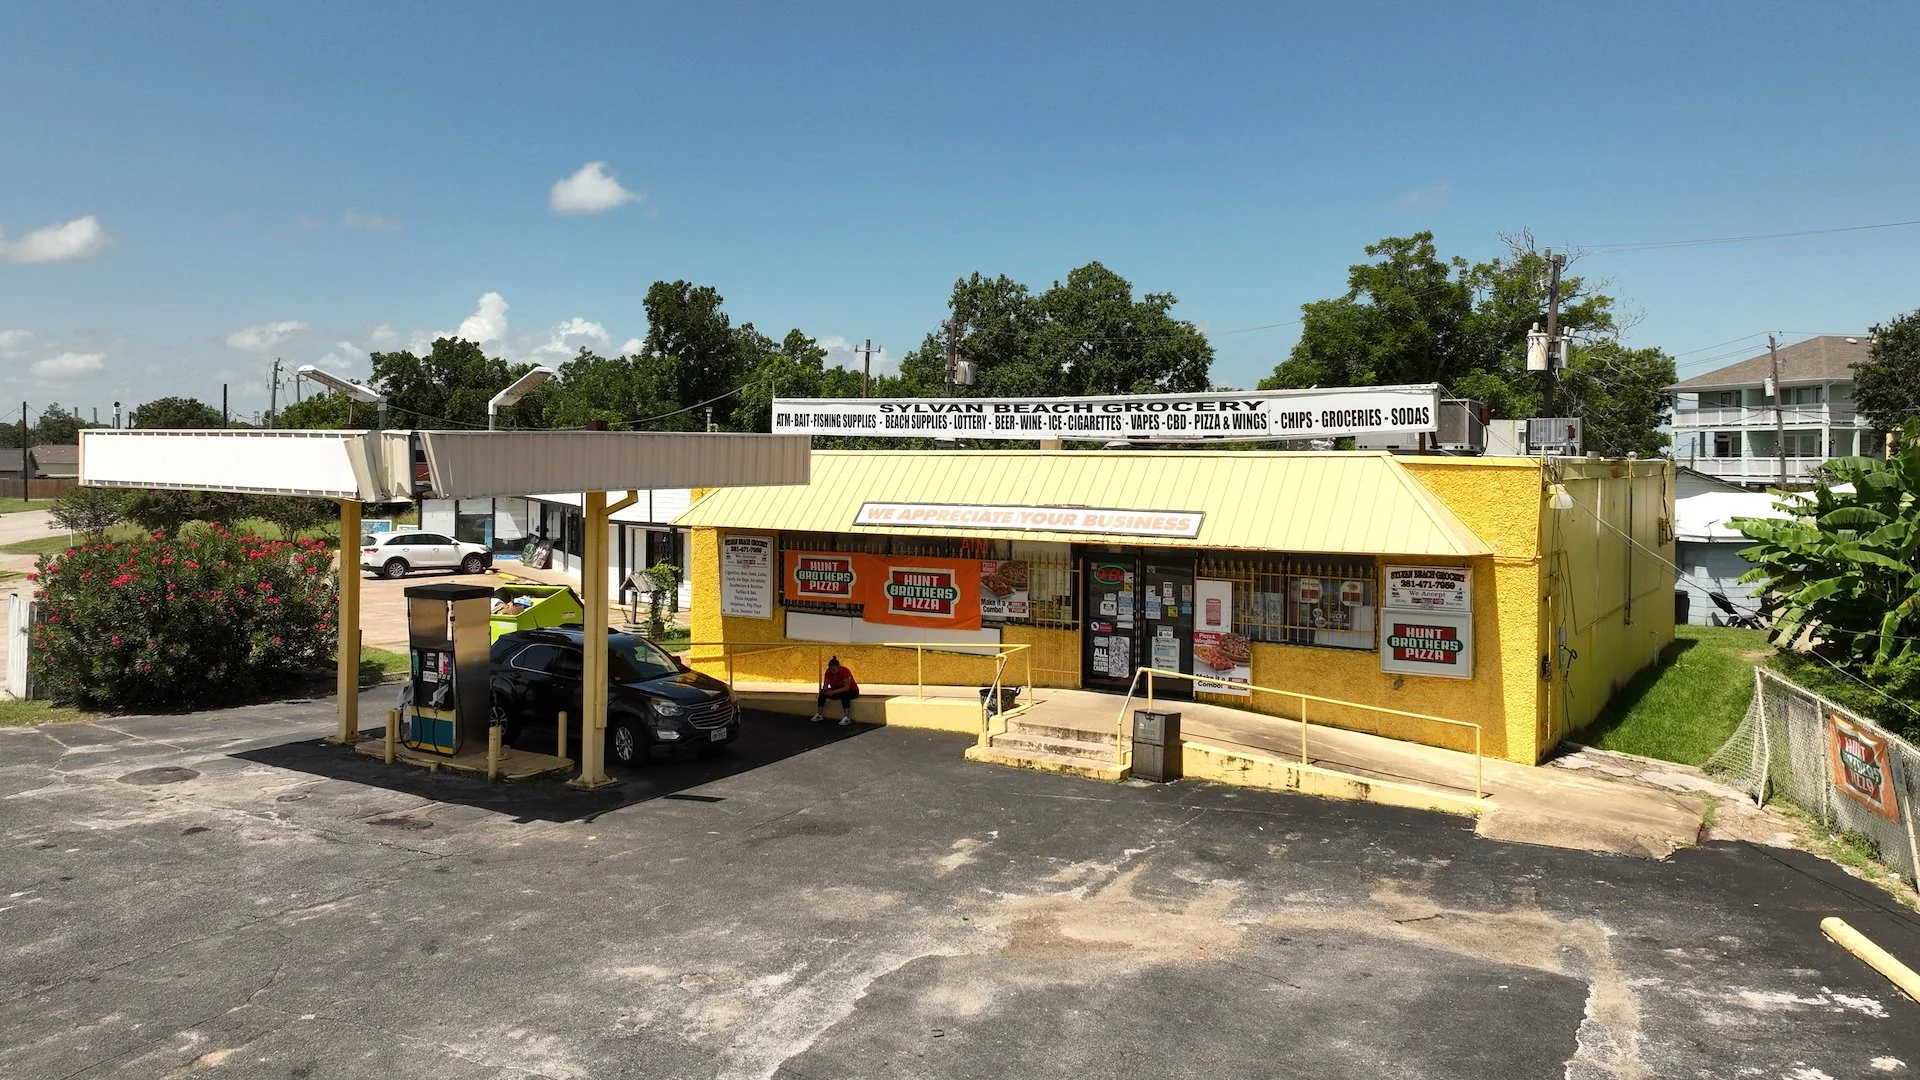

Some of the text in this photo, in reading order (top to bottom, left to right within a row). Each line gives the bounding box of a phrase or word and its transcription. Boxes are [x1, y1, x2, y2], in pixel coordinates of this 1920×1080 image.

[879, 401, 1265, 414] SYLVAN BEACH GROCERY
[843, 414, 877, 429] SUPPLIES
[885, 414, 909, 429] BEACH
[911, 414, 948, 429] SUPPLIES
[954, 414, 987, 430] LOTTERY
[995, 415, 1015, 430] BEER
[1020, 415, 1042, 430] WINE
[1048, 415, 1062, 430] ICE
[1068, 415, 1122, 430] CIGARETTES
[1131, 414, 1160, 430] VAPES
[1167, 414, 1187, 430] CBD
[1194, 413, 1221, 430] PIZZA
[1223, 415, 1230, 430] &
[1232, 413, 1267, 430] WINGS
[1281, 411, 1313, 430] CHIPS
[1321, 408, 1382, 428] GROCERIES
[1391, 406, 1430, 426] SODAS
[867, 508, 1193, 531] WE APPRECIATE YOUR BUSINESS
[809, 561, 839, 572] HUNT
[798, 570, 851, 582] BROTHERS
[903, 574, 939, 587] HUNT
[1414, 570, 1435, 579] BEACH
[1436, 571, 1465, 583] GROCERY
[809, 580, 840, 591] PIZZA
[889, 585, 953, 599] BROTHERS
[902, 597, 940, 610] PIZZA
[1405, 627, 1443, 638] HUNT
[1391, 636, 1459, 651] BROTHERS
[1093, 648, 1108, 657] ALL
[1405, 648, 1444, 661] PIZZA
